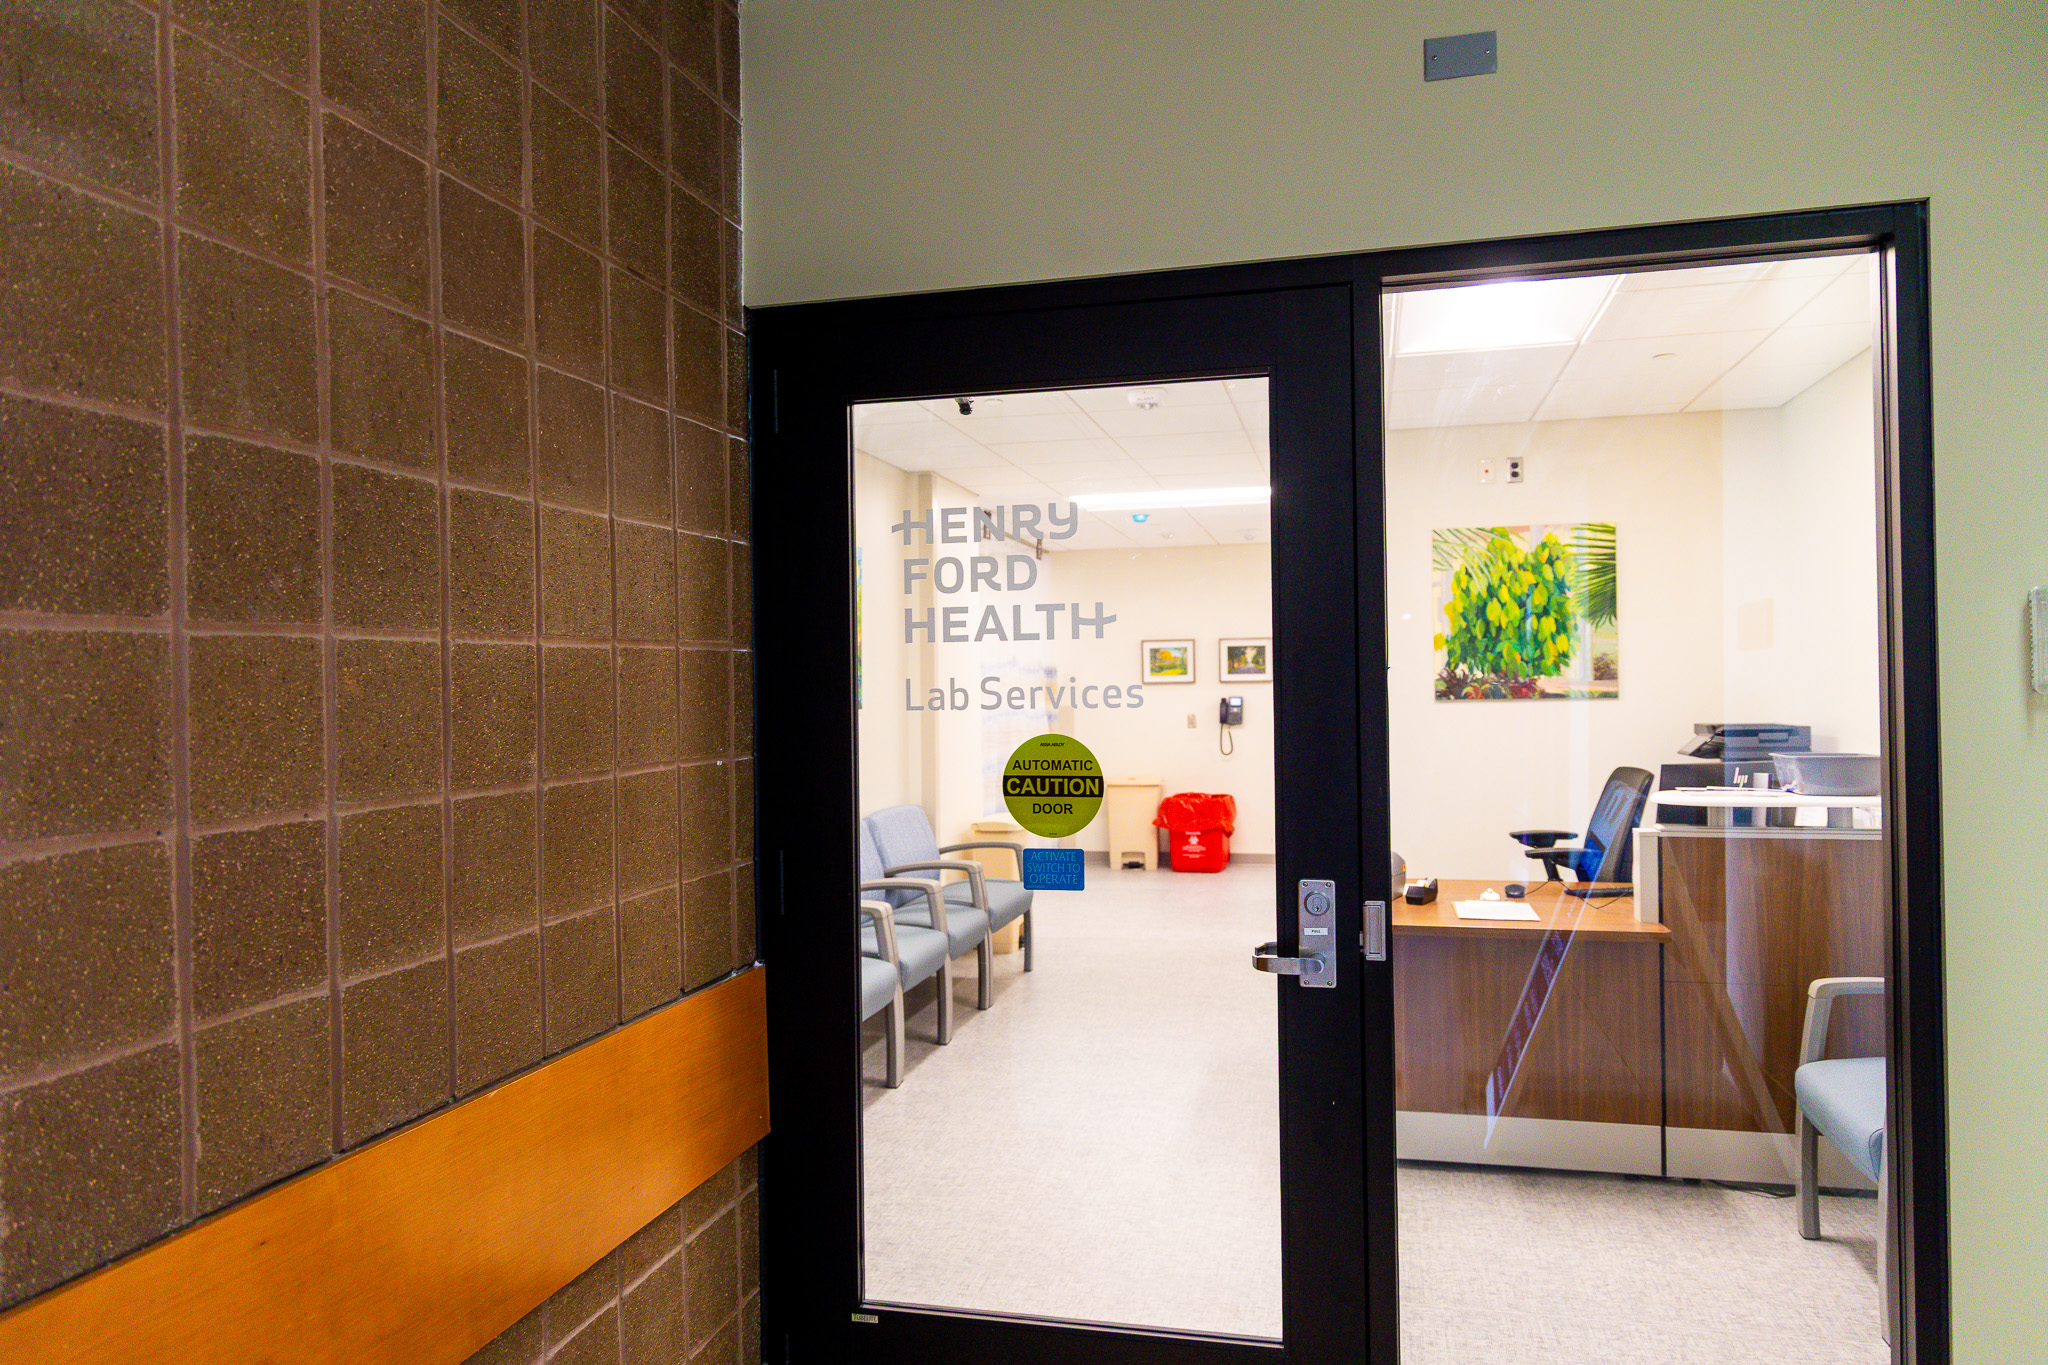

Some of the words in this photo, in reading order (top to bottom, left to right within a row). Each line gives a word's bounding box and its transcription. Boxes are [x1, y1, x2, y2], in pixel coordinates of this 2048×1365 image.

[892, 502, 1078, 545] HENRY
[904, 554, 1038, 594] FORD
[904, 602, 1117, 644] HEALTH
[905, 677, 970, 711] Lab
[980, 676, 1144, 711] Services
[1012, 760, 1093, 771] AUTOMATIC
[1006, 777, 1099, 795] CAUTION
[1032, 803, 1073, 814] DOOR
[1031, 851, 1076, 861] ACTIVATE
[1027, 863, 1064, 873] SWITCH
[1067, 863, 1080, 873] TO
[1030, 873, 1078, 884] OPERATE
